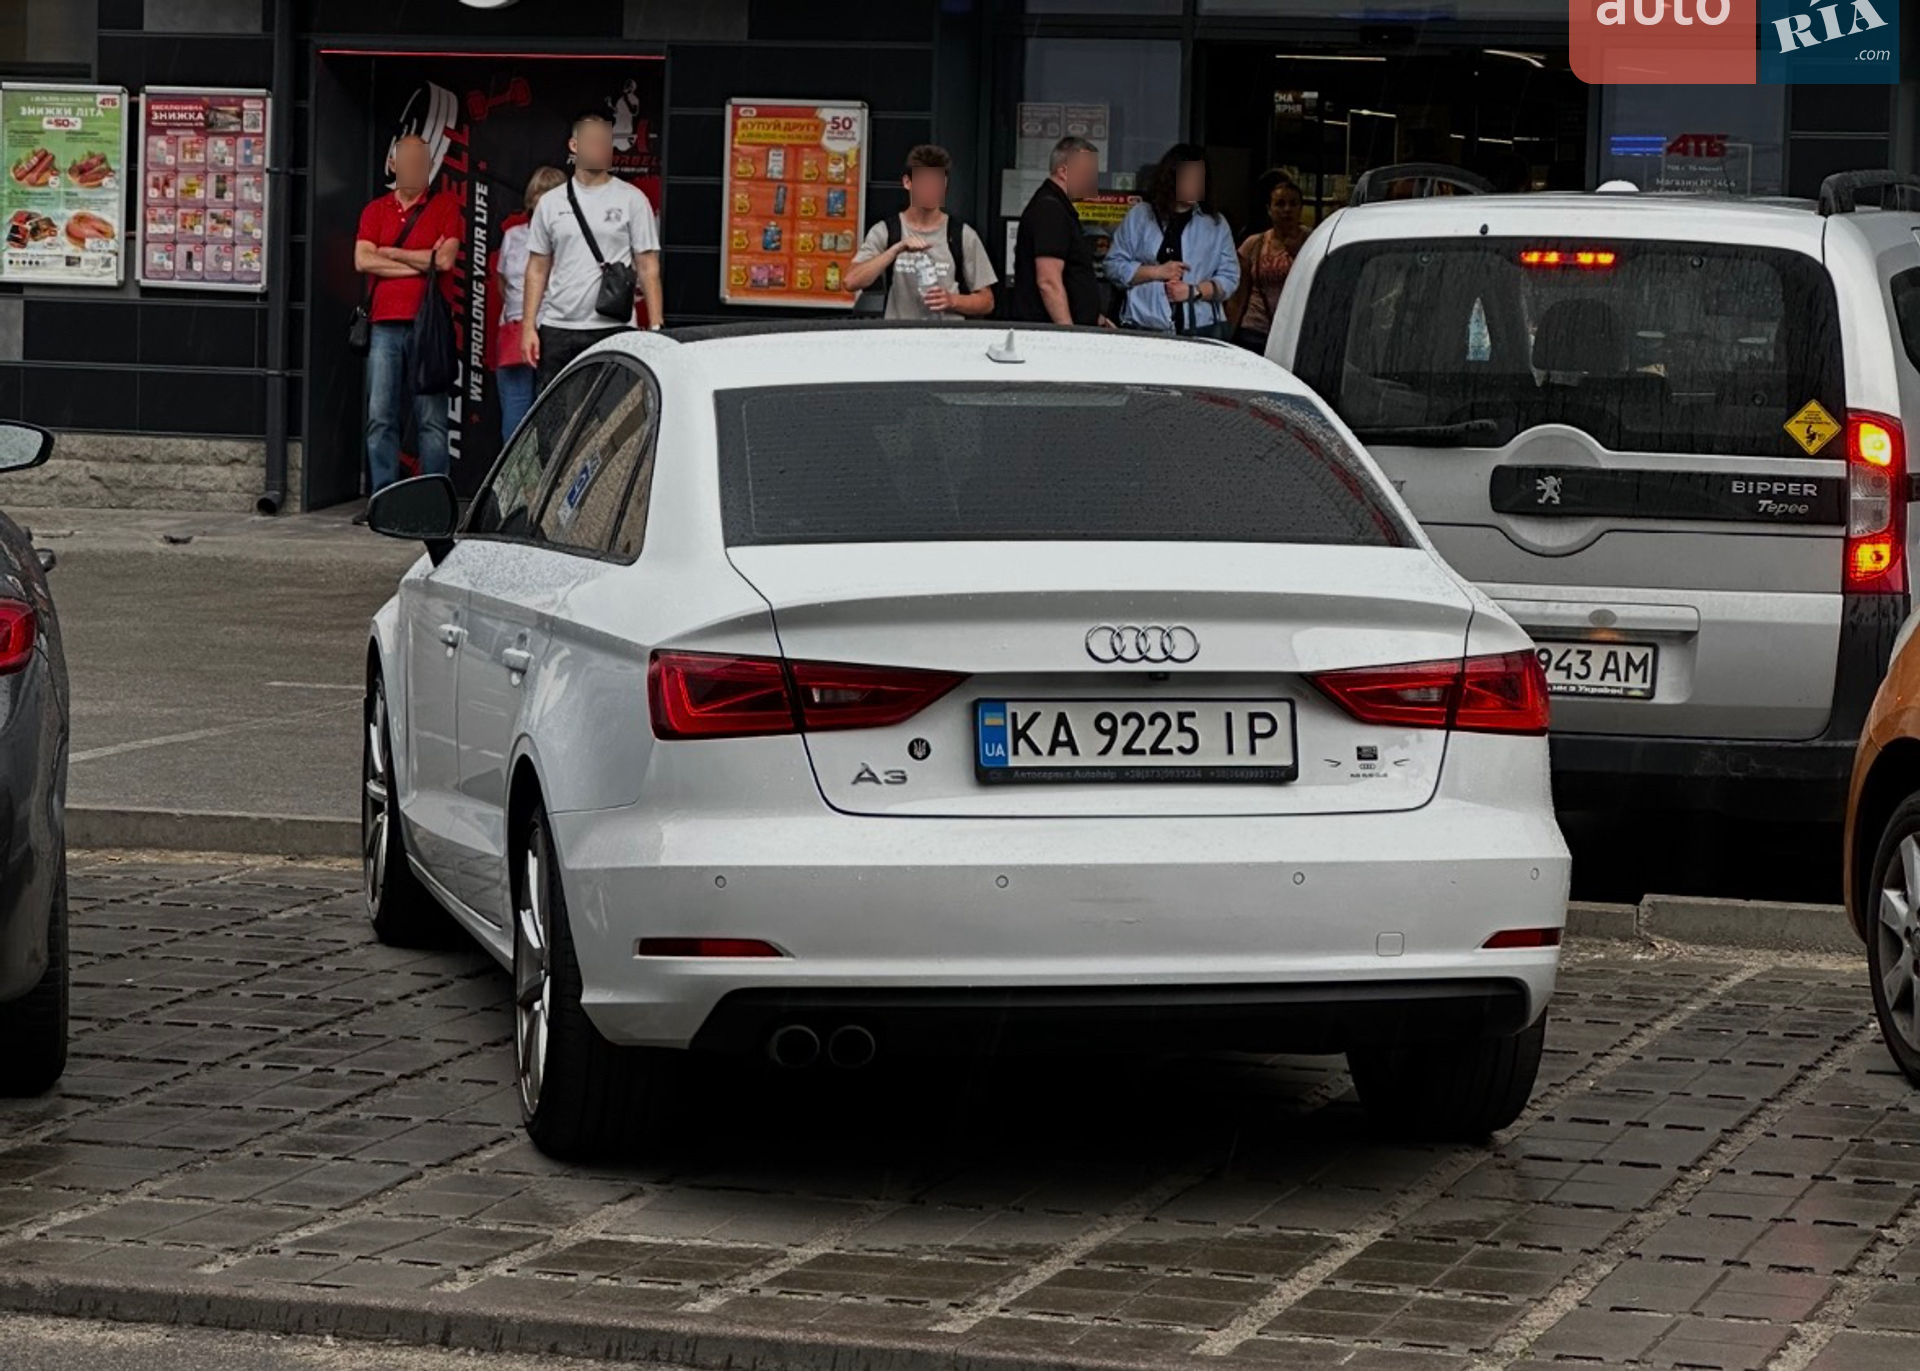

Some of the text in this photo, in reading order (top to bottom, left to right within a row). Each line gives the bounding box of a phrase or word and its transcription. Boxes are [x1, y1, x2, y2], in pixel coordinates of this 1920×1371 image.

[98, 97, 118, 107] АТБ
[20, 106, 105, 118] ЗНИЖКИ ЛІТА
[151, 110, 205, 121] ЗНИЖКА
[741, 119, 820, 132] КУПУЙ ДРУГУ
[1667, 133, 1729, 158] АТБ
[469, 181, 488, 402] WE PROLONG YOUR LIFE
[1732, 481, 1818, 497] BIPPER
[1758, 500, 1809, 515] Tepee
[1599, 650, 1650, 684] AM
[1010, 711, 1279, 757] KA 9225 IP
[985, 743, 1006, 757] UA
[851, 762, 908, 786] A3
